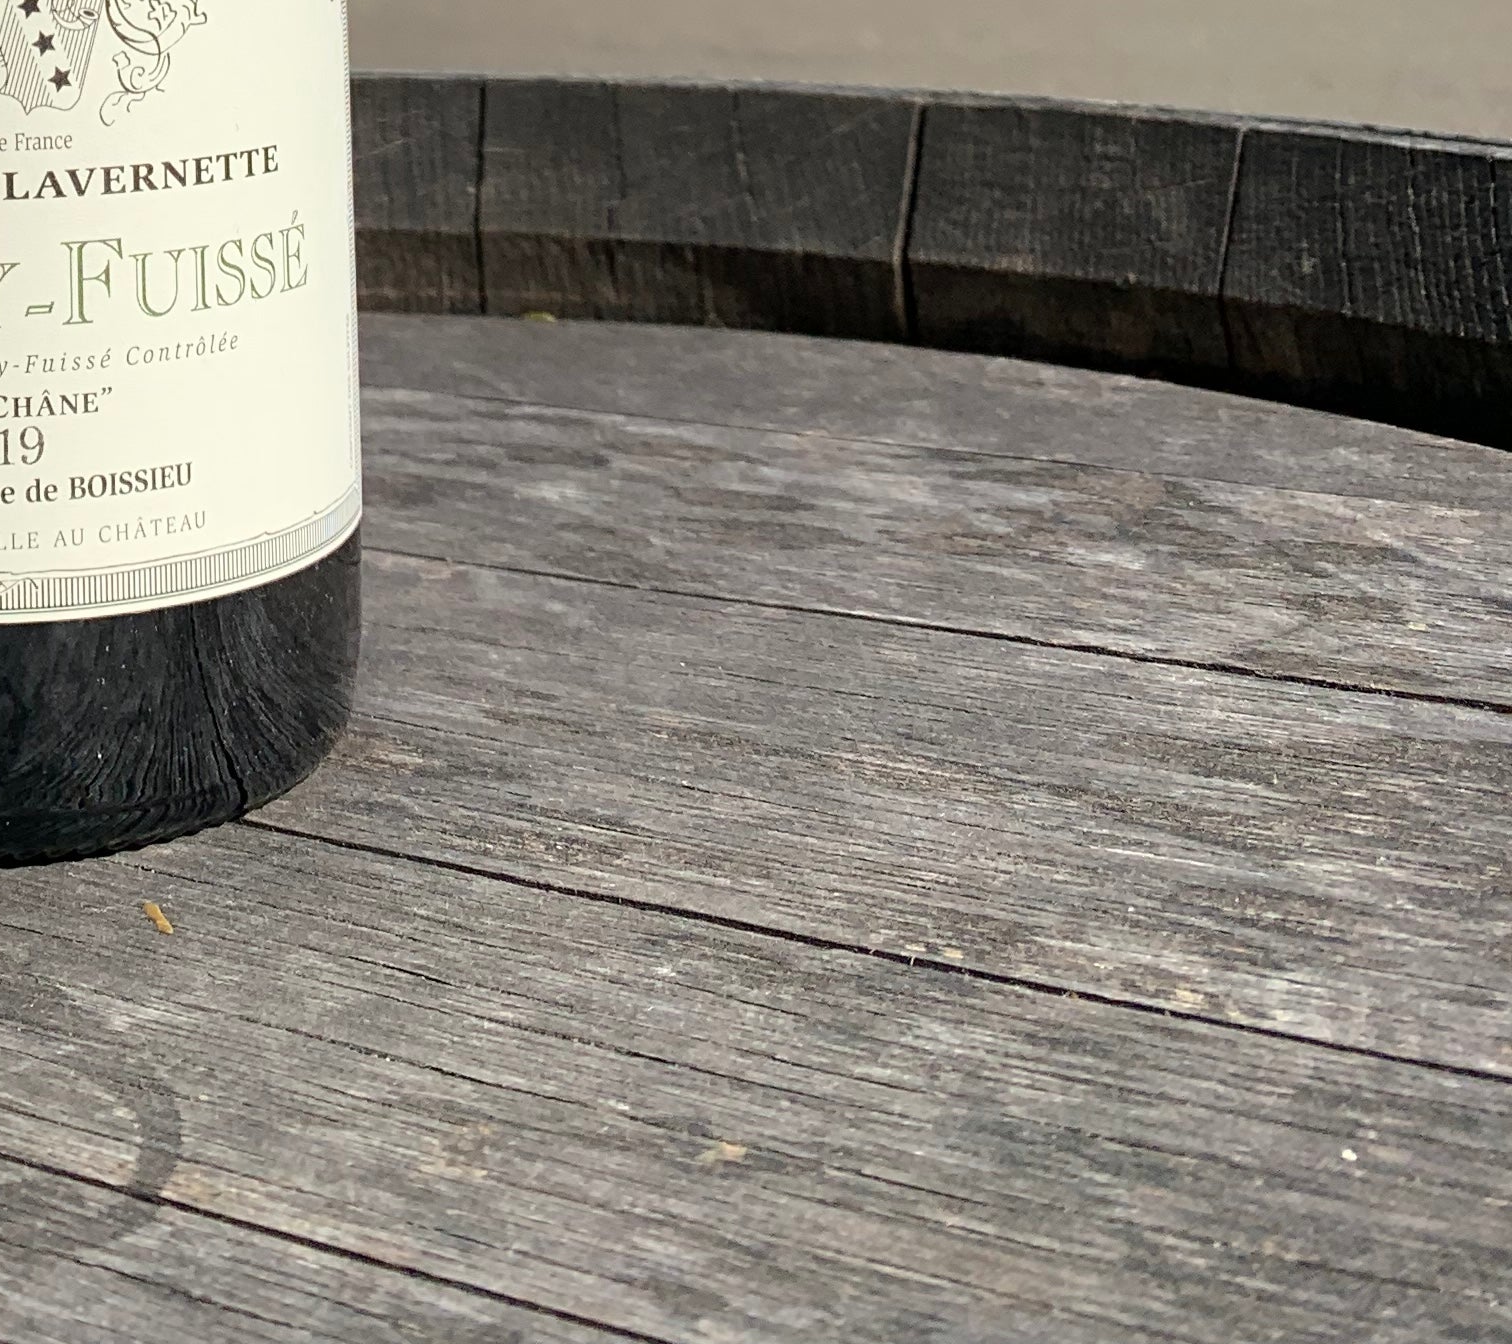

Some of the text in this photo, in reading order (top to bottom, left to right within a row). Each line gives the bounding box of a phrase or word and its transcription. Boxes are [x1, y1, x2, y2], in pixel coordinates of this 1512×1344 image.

[14, 133, 73, 152] France
[2, 145, 279, 201] LAVERNETTE
[126, 332, 239, 367] Contrôlée
[25, 476, 58, 503] de
[68, 462, 194, 501] BOISSIEU
[53, 528, 85, 549] AU
[97, 510, 207, 545] CHÂTEAU
